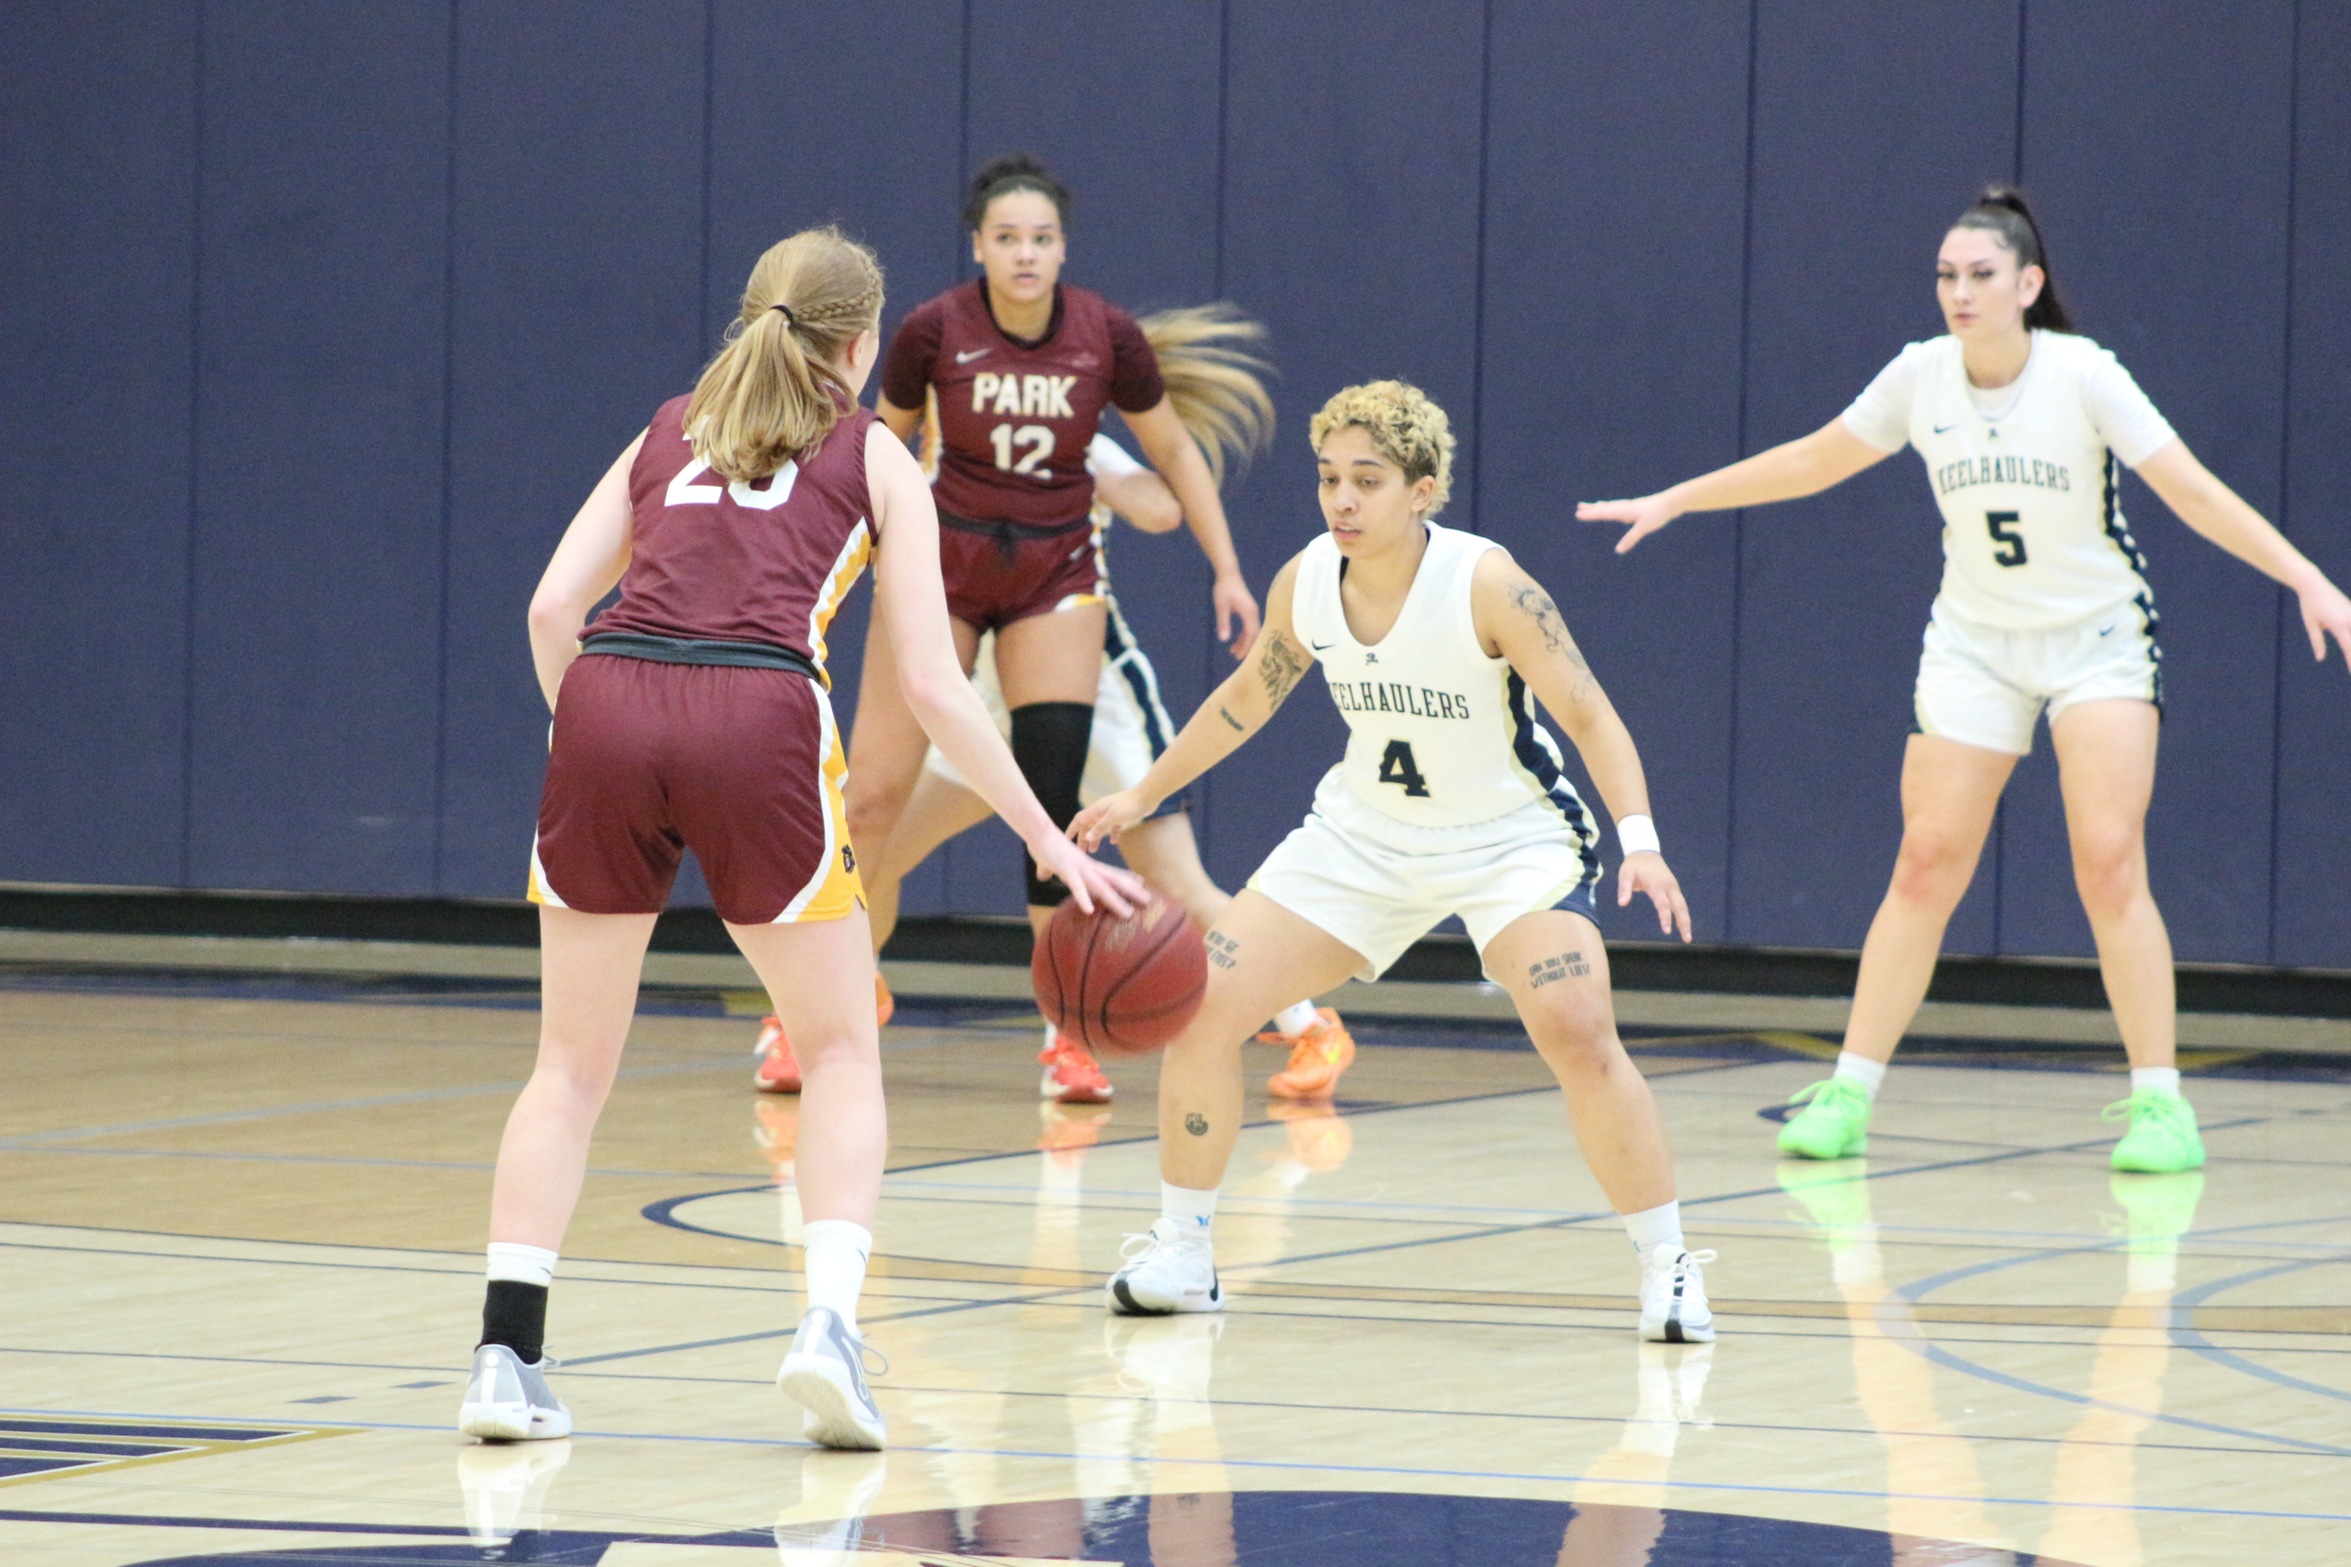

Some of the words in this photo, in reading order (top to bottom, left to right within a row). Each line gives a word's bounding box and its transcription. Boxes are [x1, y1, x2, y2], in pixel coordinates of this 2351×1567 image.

[971, 371, 1079, 419] PARK
[989, 423, 1056, 480] 12
[1936, 455, 2070, 495] KEELHAULERS
[1985, 510, 2028, 568] 5
[1328, 681, 1470, 720] EELHAULERS
[1379, 738, 1431, 798] 4
